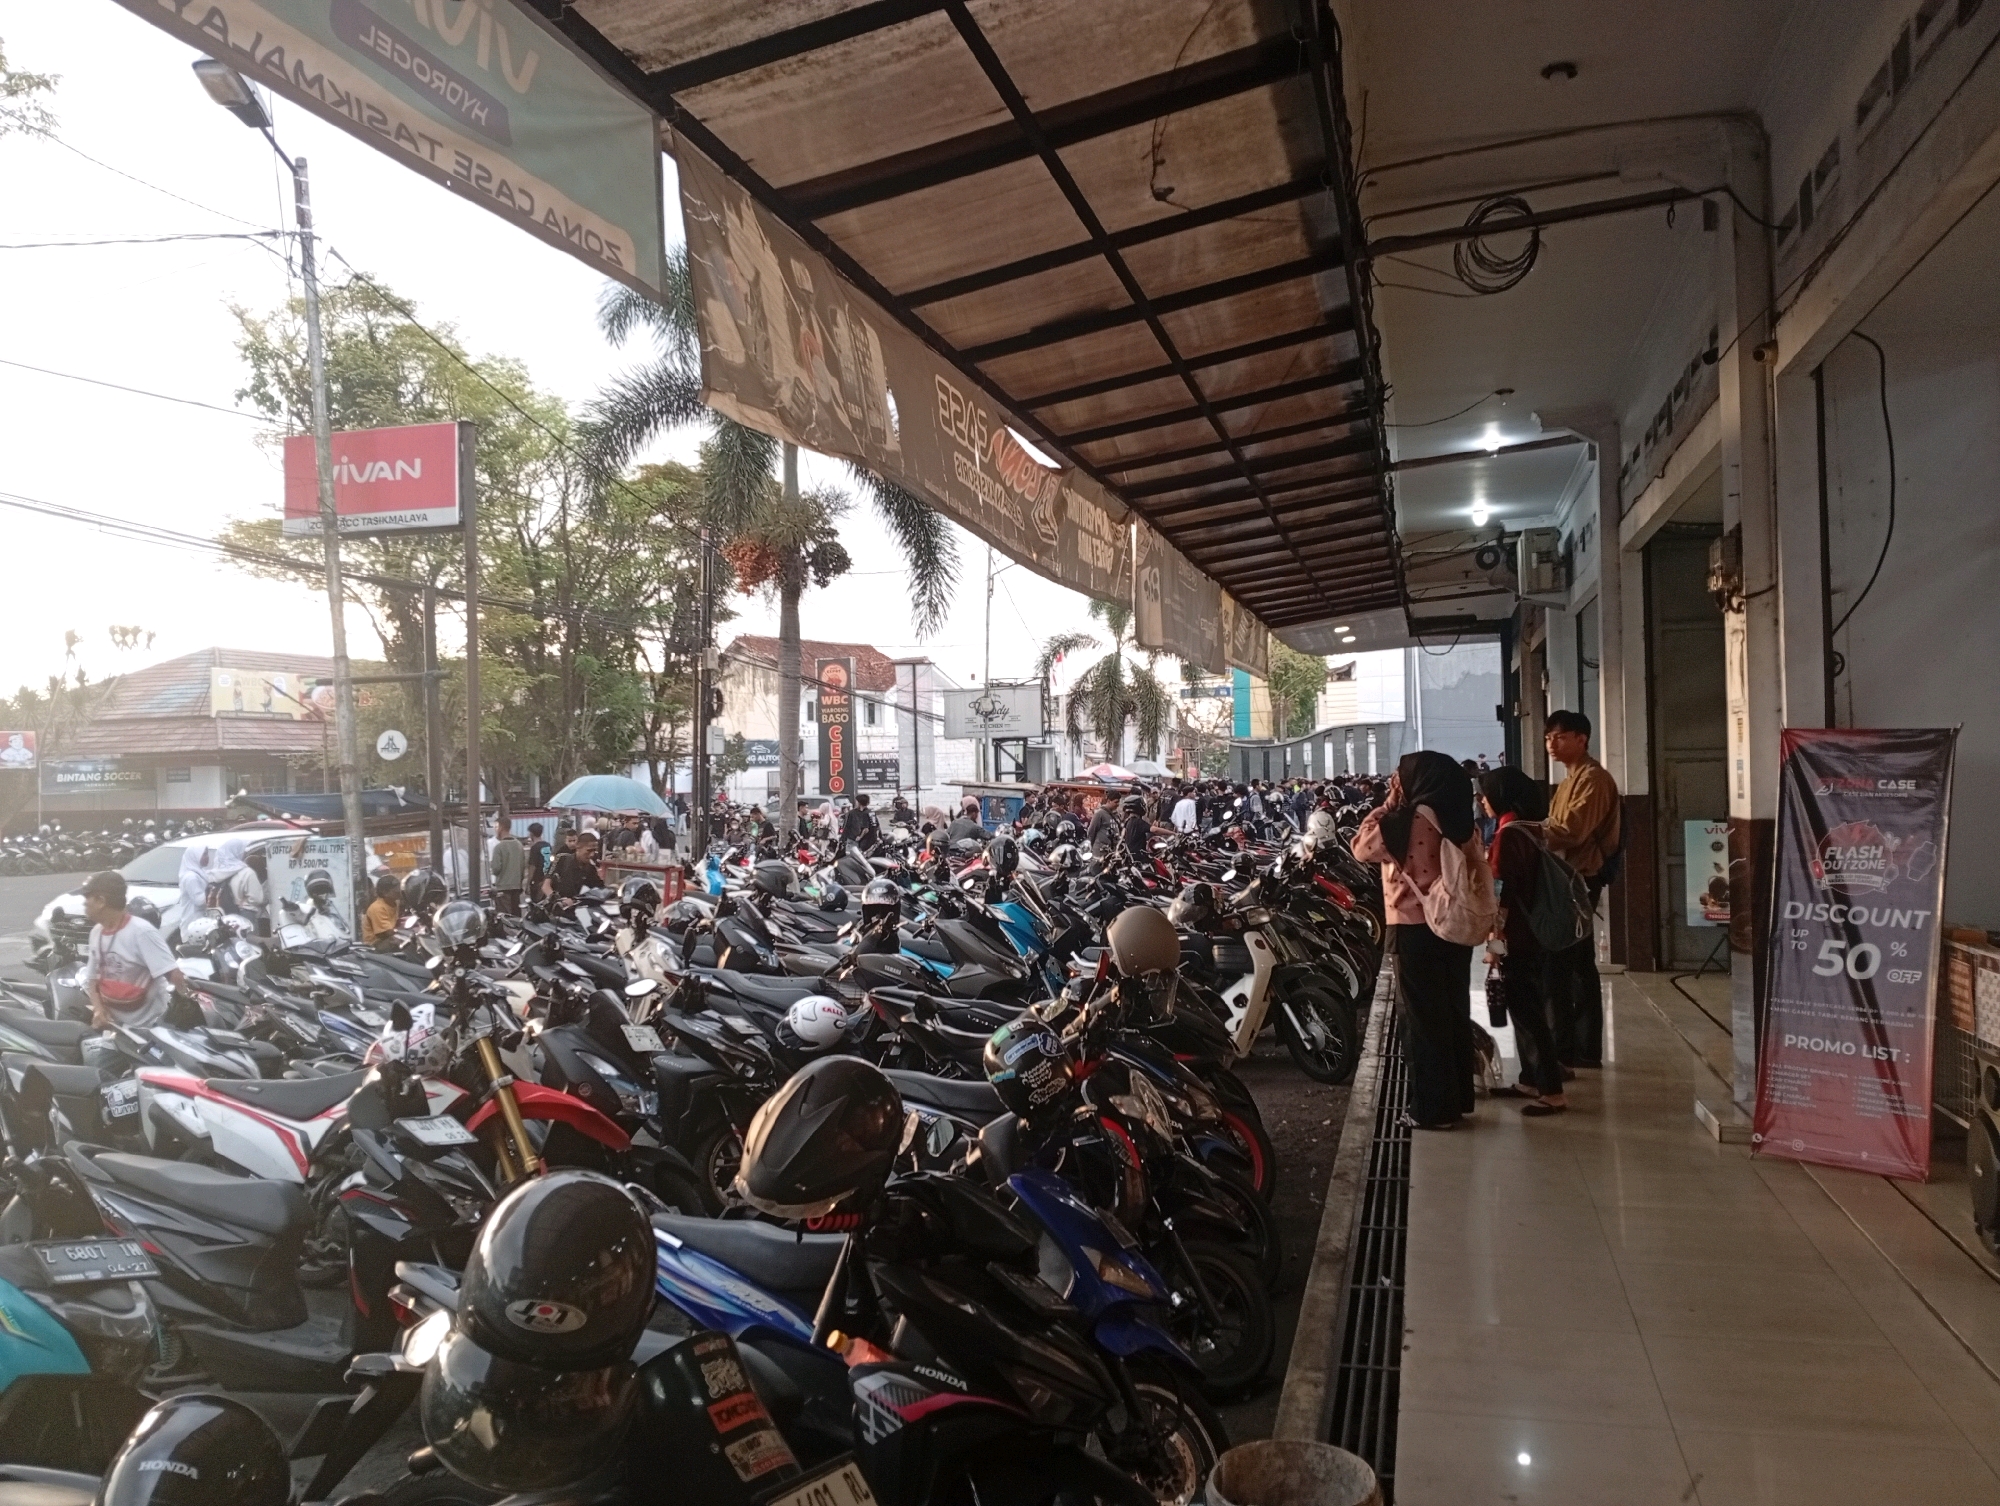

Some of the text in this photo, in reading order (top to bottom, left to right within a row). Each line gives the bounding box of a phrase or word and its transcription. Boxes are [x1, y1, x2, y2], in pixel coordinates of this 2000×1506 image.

[339, 519, 359, 528] ACC
[362, 513, 428, 527] TASIKMALAYA
[821, 695, 849, 705] WBC
[821, 713, 849, 723] BASO
[56, 771, 142, 783] BINTANG SOCCER
[1878, 780, 1916, 790] CASE
[318, 845, 328, 854] ALL
[329, 844, 345, 854] TYPE
[1825, 845, 1884, 860] FLASH
[1784, 901, 1931, 930] DISCOUNT
[1791, 928, 1809, 938] UP
[1790, 941, 1808, 951] TO
[1812, 939, 1908, 980] 50 %
[1886, 969, 1922, 984] OFF
[1784, 1034, 1857, 1056] PROMO
[1862, 1045, 1901, 1063] LIST
[42, 1248, 56, 1264] Z
[65, 1245, 107, 1261] 6807
[913, 1364, 969, 1392] HONDA
[138, 1459, 199, 1480] HONDA
